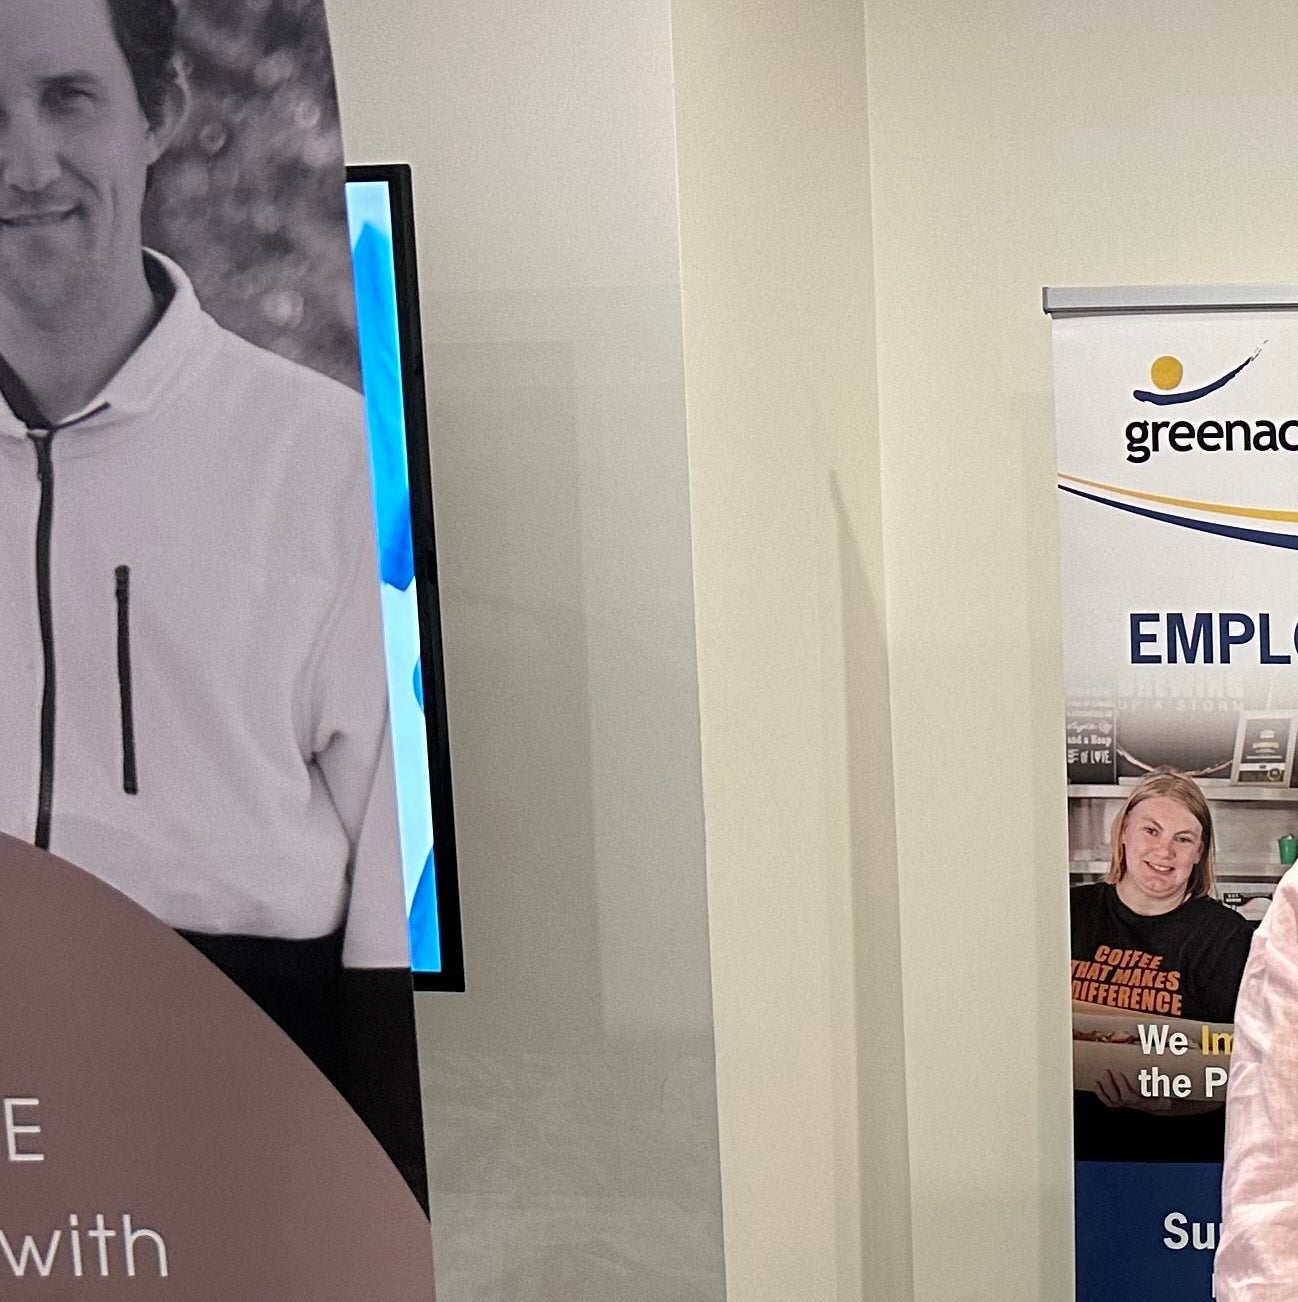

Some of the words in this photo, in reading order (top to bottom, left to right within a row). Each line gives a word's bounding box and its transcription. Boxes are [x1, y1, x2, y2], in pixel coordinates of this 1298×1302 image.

[1095, 945, 1163, 969] COFFEE
[1111, 969, 1180, 991] MAKES
[1138, 1024, 1188, 1055] We
[1138, 1067, 1192, 1098] the
[0, 1214, 169, 1277] with
[1163, 1212, 1222, 1251] Su
